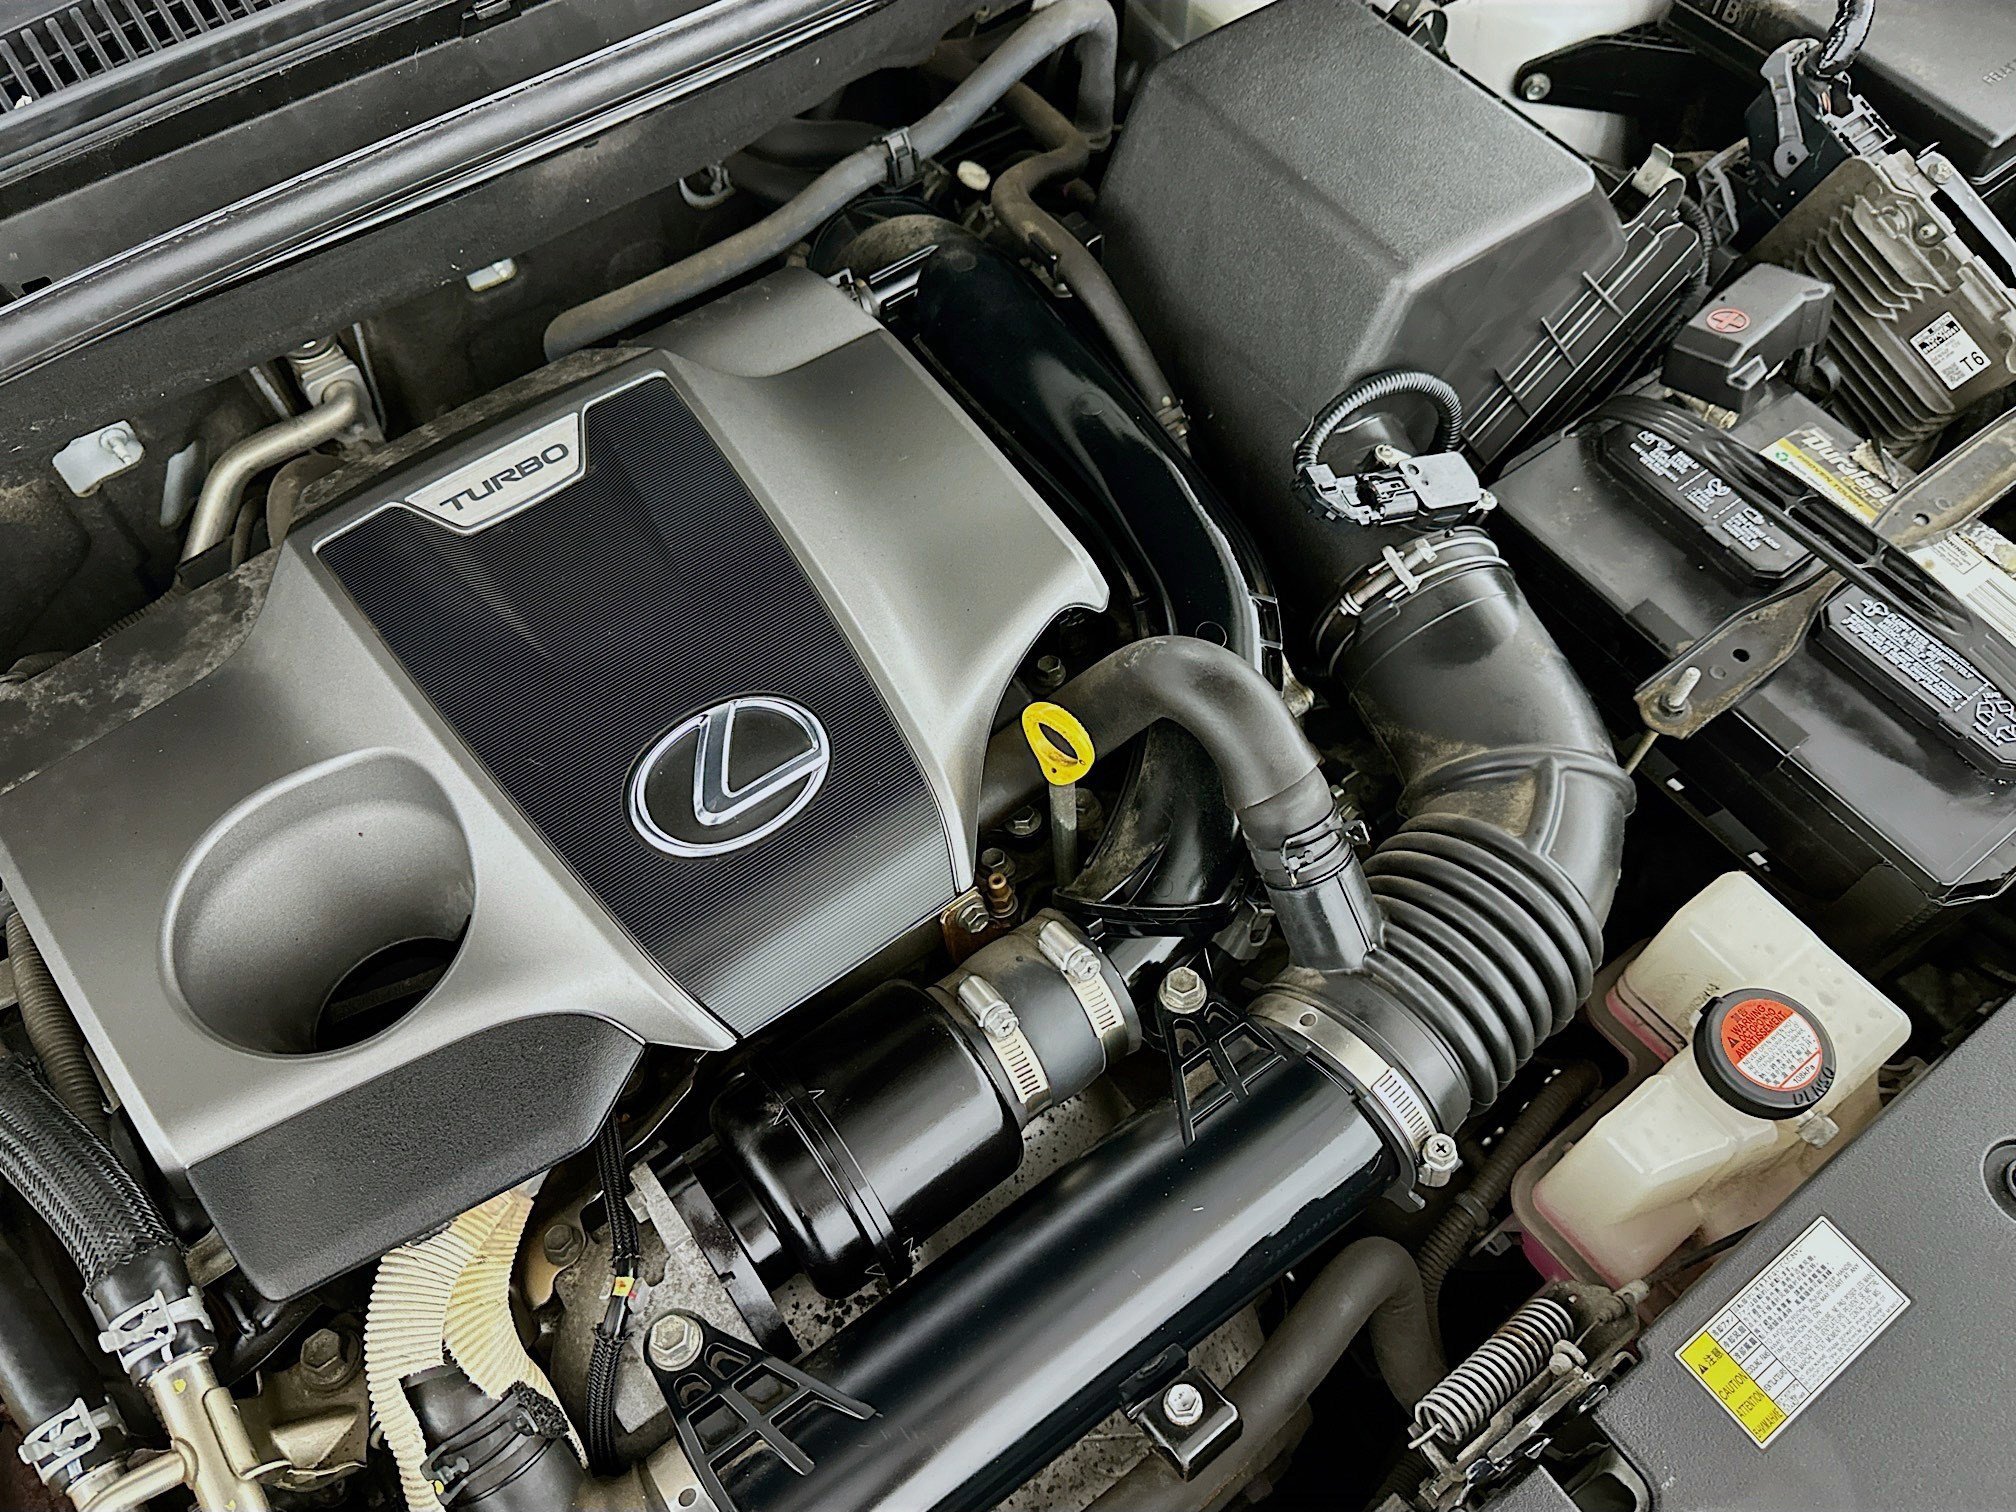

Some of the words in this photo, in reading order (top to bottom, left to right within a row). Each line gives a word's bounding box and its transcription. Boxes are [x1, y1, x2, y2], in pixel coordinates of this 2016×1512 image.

[439, 443, 569, 511] TURBO
[1730, 1002, 1765, 1037] WARNING
[1734, 1009, 1786, 1060] AVERTISSEMENT
[1702, 1346, 1723, 1367] 注意
[1717, 1370, 1748, 1400] CAUTION
[1735, 1388, 1765, 1418] ATTENTION
